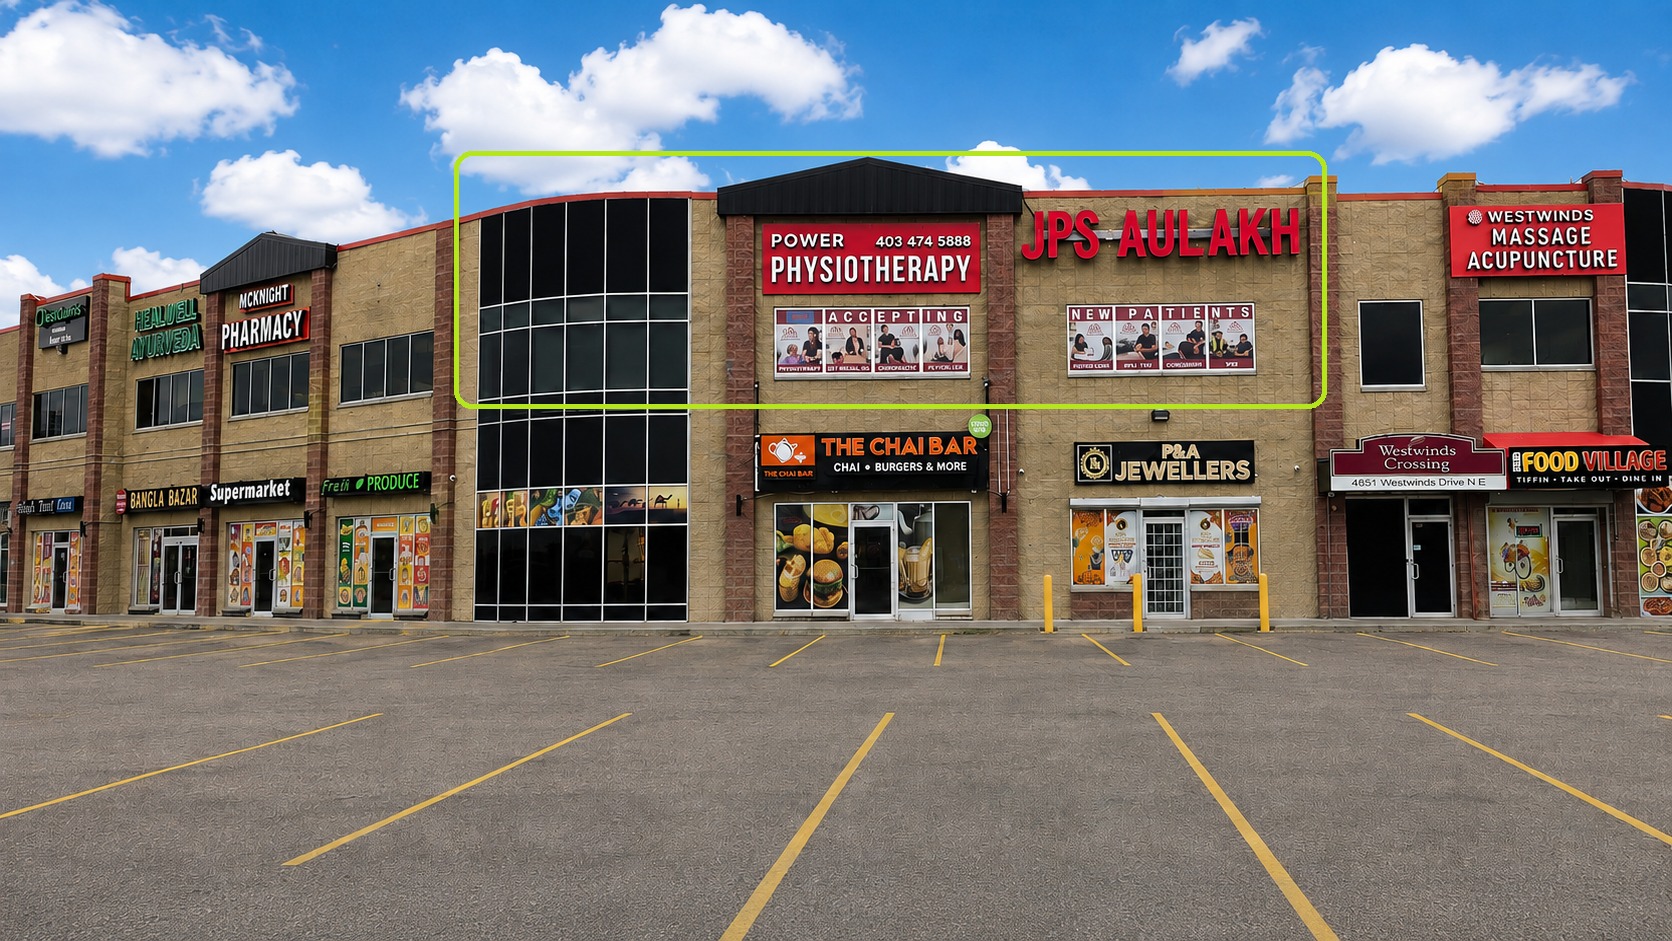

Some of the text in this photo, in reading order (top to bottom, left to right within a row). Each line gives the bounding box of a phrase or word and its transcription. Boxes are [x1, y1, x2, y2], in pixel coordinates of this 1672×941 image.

[1487, 209, 1594, 223] WESTWINDS
[771, 233, 844, 248] POWER
[875, 235, 971, 247] 403 474 5888
[1021, 207, 1300, 260] JPS AULAKH
[1492, 226, 1592, 246] MASSAGE
[771, 255, 971, 283] PHYSIOTHERAPY
[1467, 249, 1618, 270] ACUPUNCTURE
[239, 284, 289, 309] MCKNIGHT
[134, 298, 198, 333] HEALWELL
[828, 311, 963, 323] ACCEPTING
[1071, 306, 1250, 320] NEW PATIENTS
[221, 310, 303, 350] PHARMACY
[130, 322, 201, 361] AYURVEDA
[821, 436, 978, 457] THE CHAI BAR
[1161, 444, 1201, 459] P&A
[1378, 444, 1457, 456] Westwinds
[833, 461, 967, 472] CHAI BURGERS & MORE
[1115, 460, 1250, 481] JEWELLERS
[1384, 457, 1450, 473] Crossing
[1521, 450, 1579, 473] FOOD
[1581, 449, 1668, 471] VILLAGE
[209, 479, 291, 504] Supermarket
[367, 473, 420, 491] PRODUCE
[1380, 478, 1436, 487] Westwinds
[1438, 478, 1465, 487] Drive
[130, 490, 165, 509] BANGLA
[168, 487, 198, 507] BAZAR
